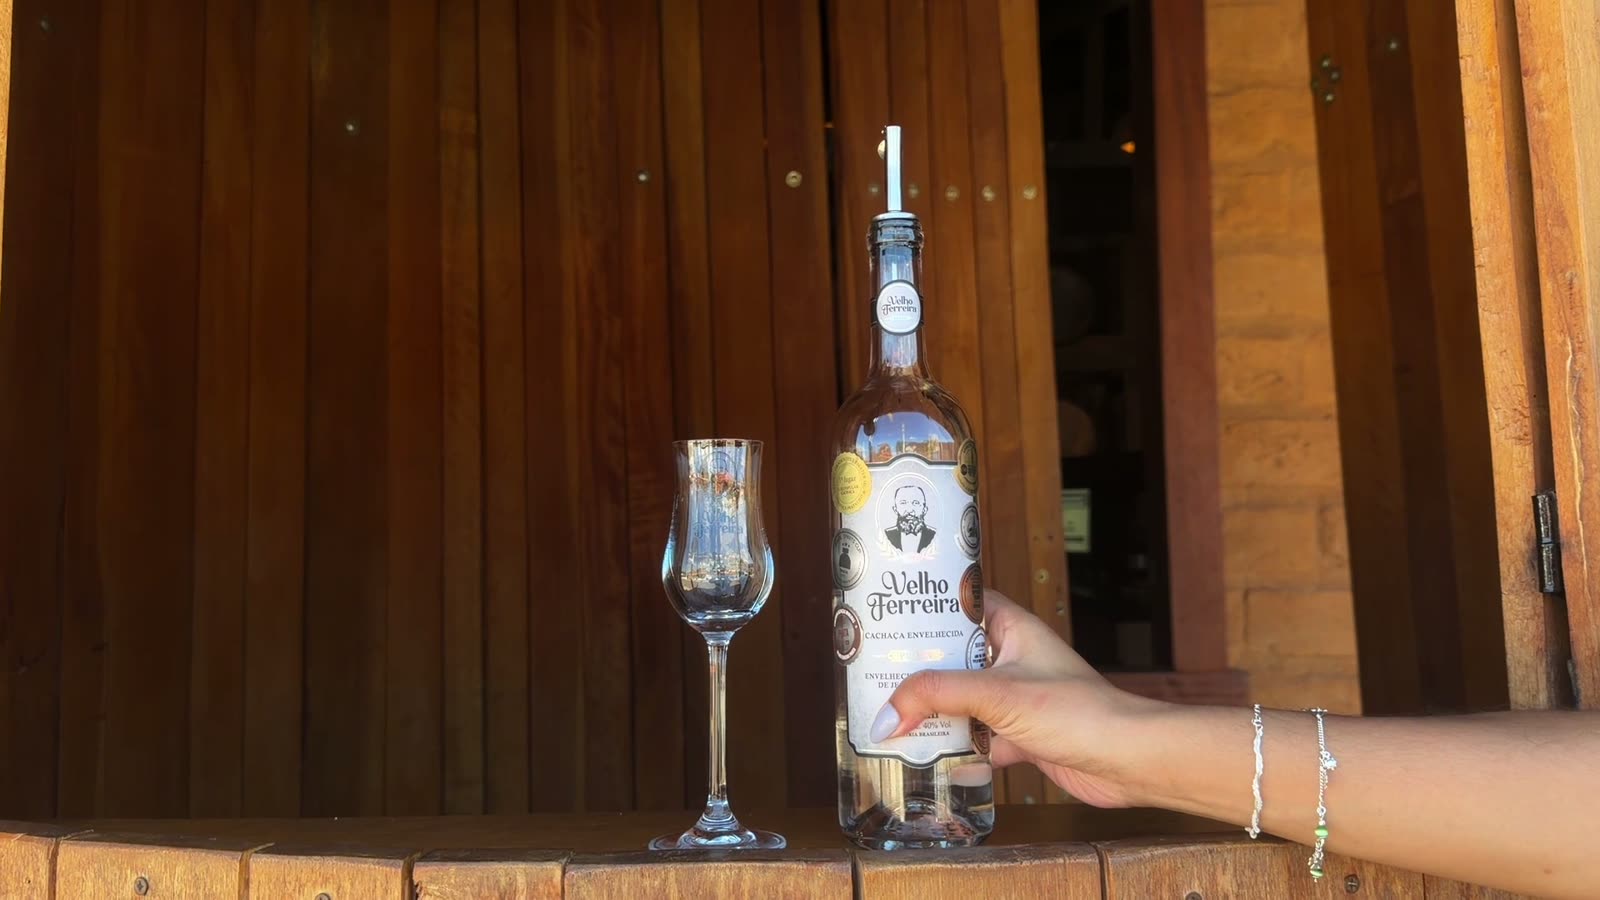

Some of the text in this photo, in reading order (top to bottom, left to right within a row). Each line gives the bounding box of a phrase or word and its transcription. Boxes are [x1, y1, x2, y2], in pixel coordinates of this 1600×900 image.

[887, 295, 913, 305] Velho
[881, 303, 917, 315] Ferreira
[881, 570, 949, 595] Velho
[866, 592, 960, 622] Ferreira
[864, 630, 965, 640] CACHAÇA ENVELHECIDA
[878, 681, 889, 689] DE
[922, 721, 939, 729] 40%
